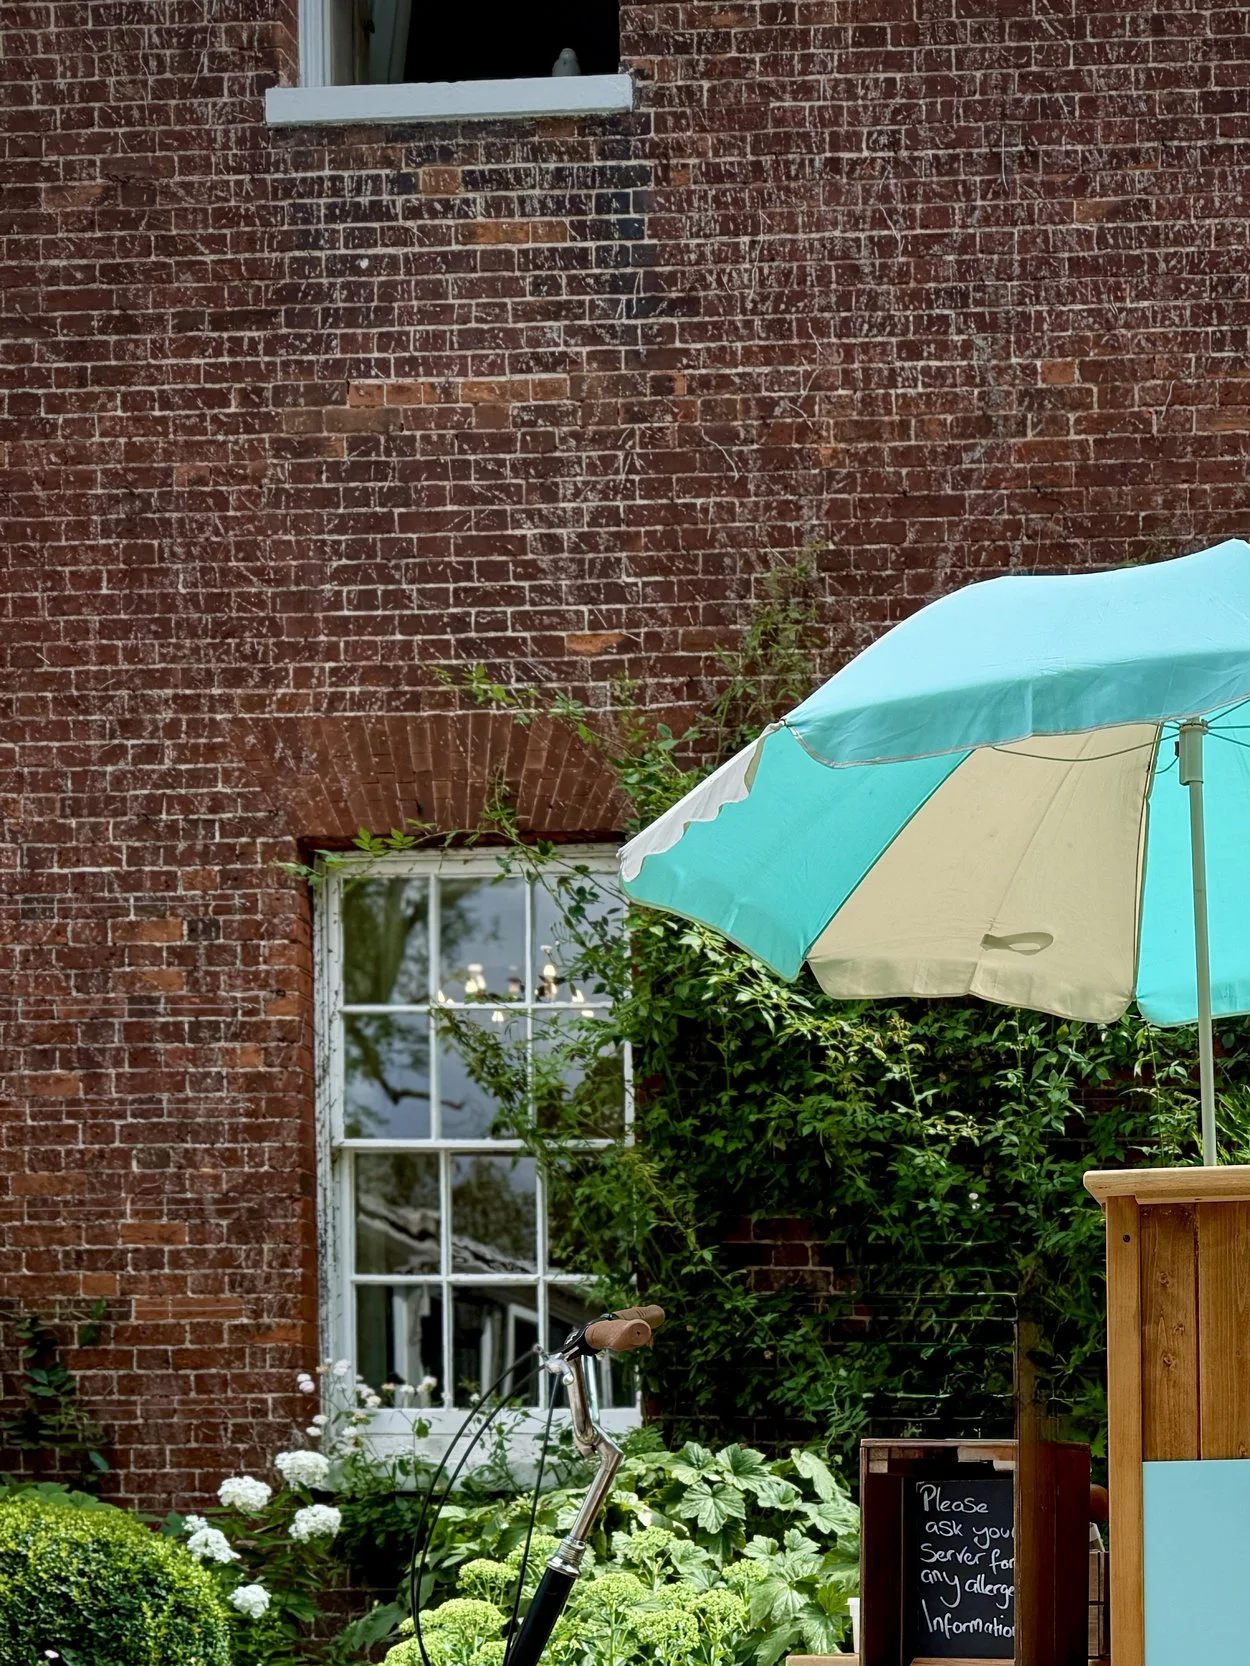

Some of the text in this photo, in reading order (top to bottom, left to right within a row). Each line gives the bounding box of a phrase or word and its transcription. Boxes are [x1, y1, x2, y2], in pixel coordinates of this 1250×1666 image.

[918, 1484, 989, 1513] Please
[925, 1520, 963, 1537] ask
[920, 1543, 986, 1566] Server
[920, 1569, 961, 1609] any
